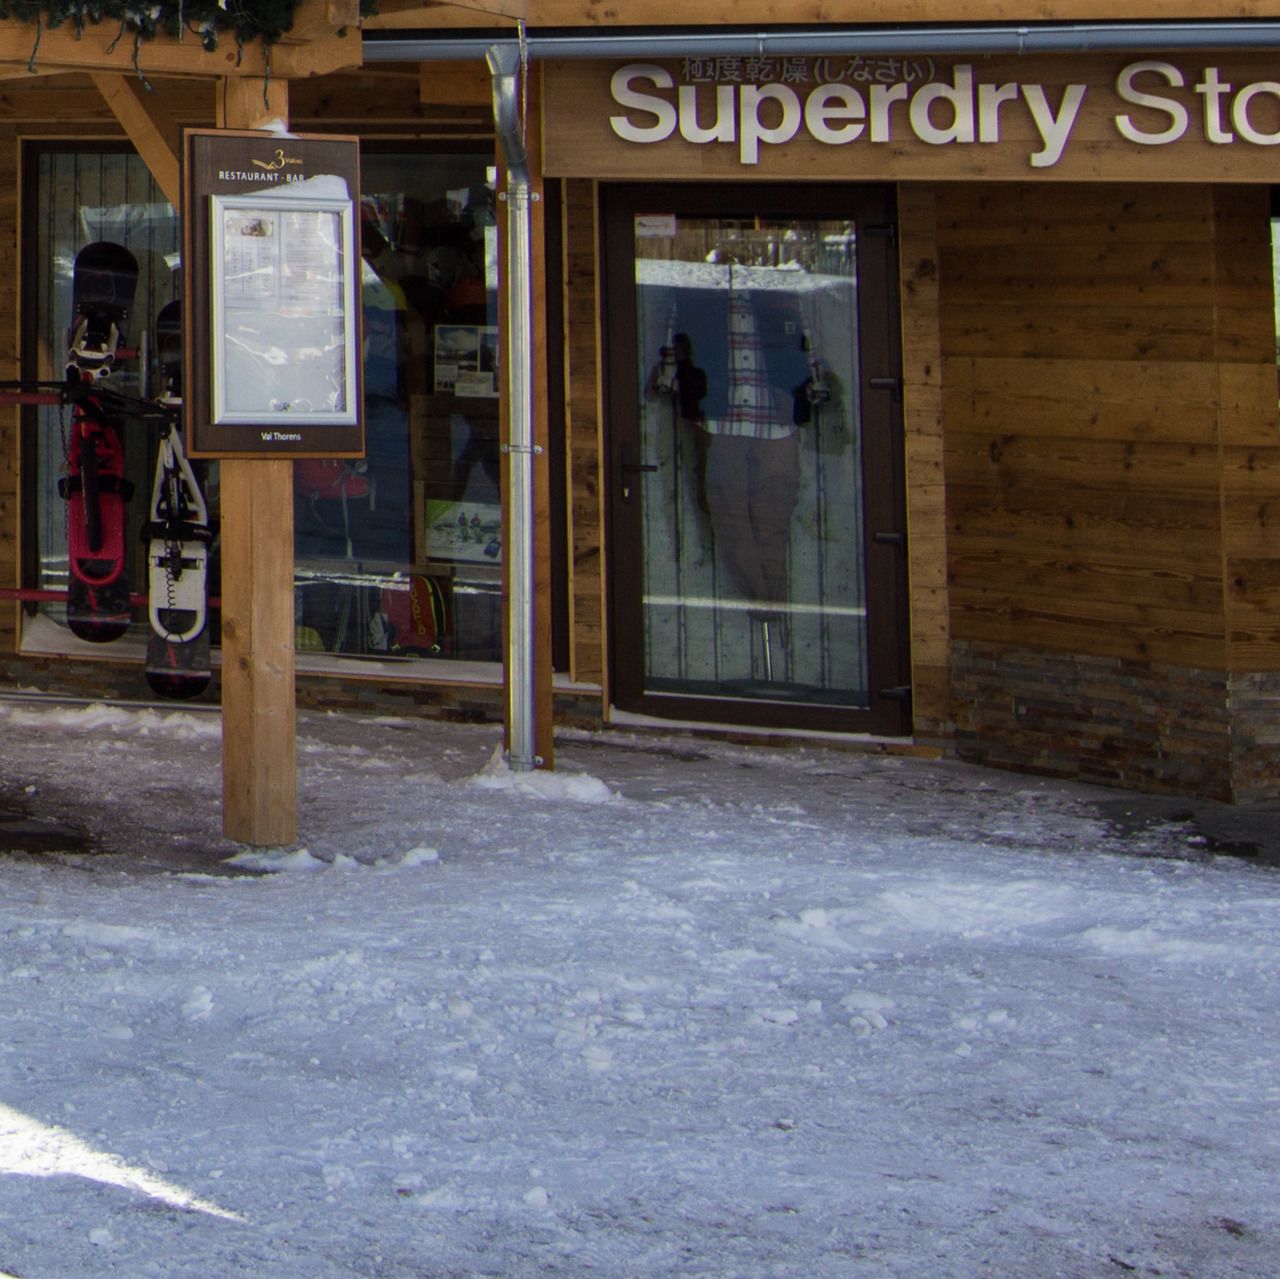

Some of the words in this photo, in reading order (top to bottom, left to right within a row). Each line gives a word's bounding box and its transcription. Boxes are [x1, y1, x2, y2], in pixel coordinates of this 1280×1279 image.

[609, 63, 1088, 167] Superdry
[1114, 60, 1280, 145] Sto
[274, 148, 286, 169] 3
[218, 170, 280, 182] RESTAURANT
[286, 173, 305, 182] BAR
[261, 431, 273, 441] Val
[273, 431, 302, 441] Thorens
